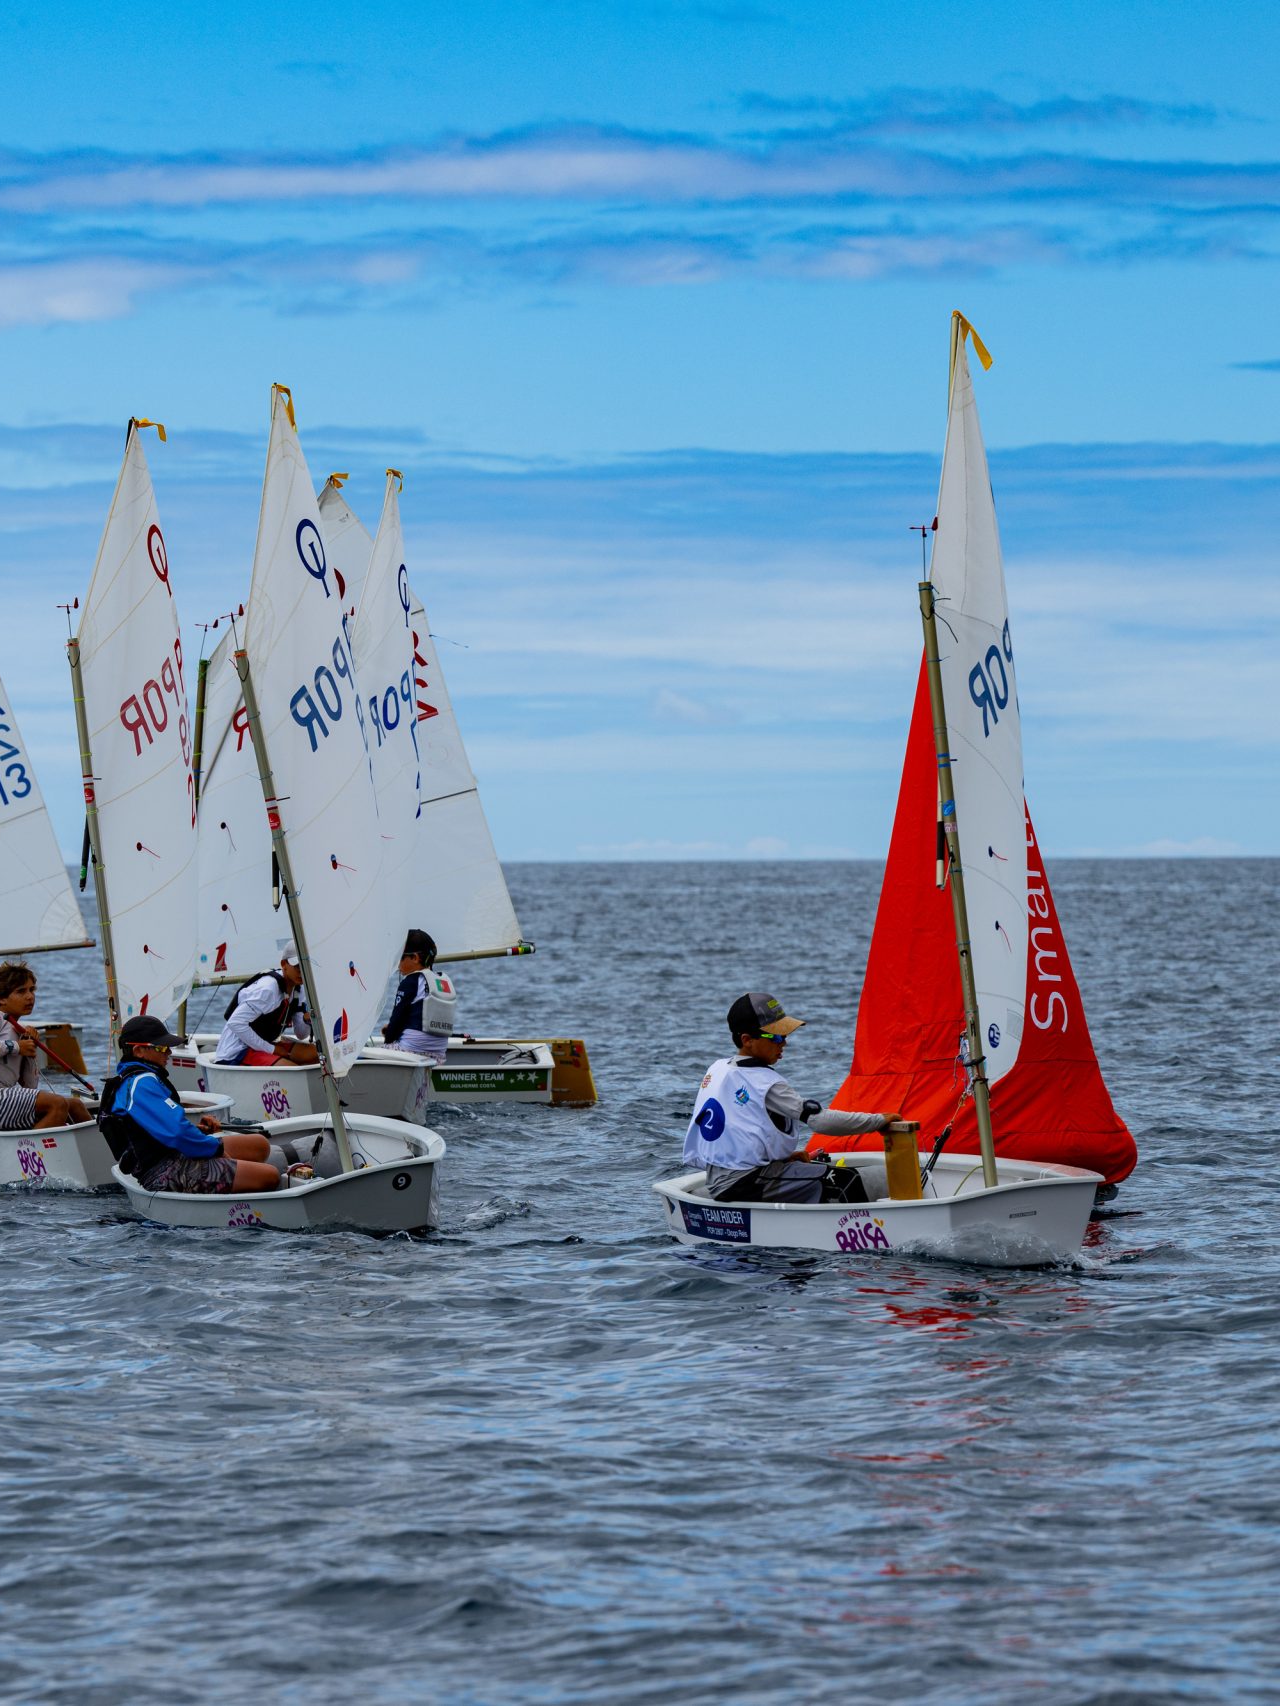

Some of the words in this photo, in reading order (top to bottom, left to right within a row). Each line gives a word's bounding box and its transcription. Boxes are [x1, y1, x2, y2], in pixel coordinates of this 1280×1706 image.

[440, 1072, 477, 1081] WINNER
[479, 1072, 504, 1081] TEAM
[261, 1088, 290, 1114] BRISA
[704, 1108, 714, 1129] 2
[398, 1176, 406, 1187] 9
[702, 1208, 720, 1222] TEAM
[720, 1211, 744, 1225] RIDER
[838, 1215, 848, 1228] SEM
